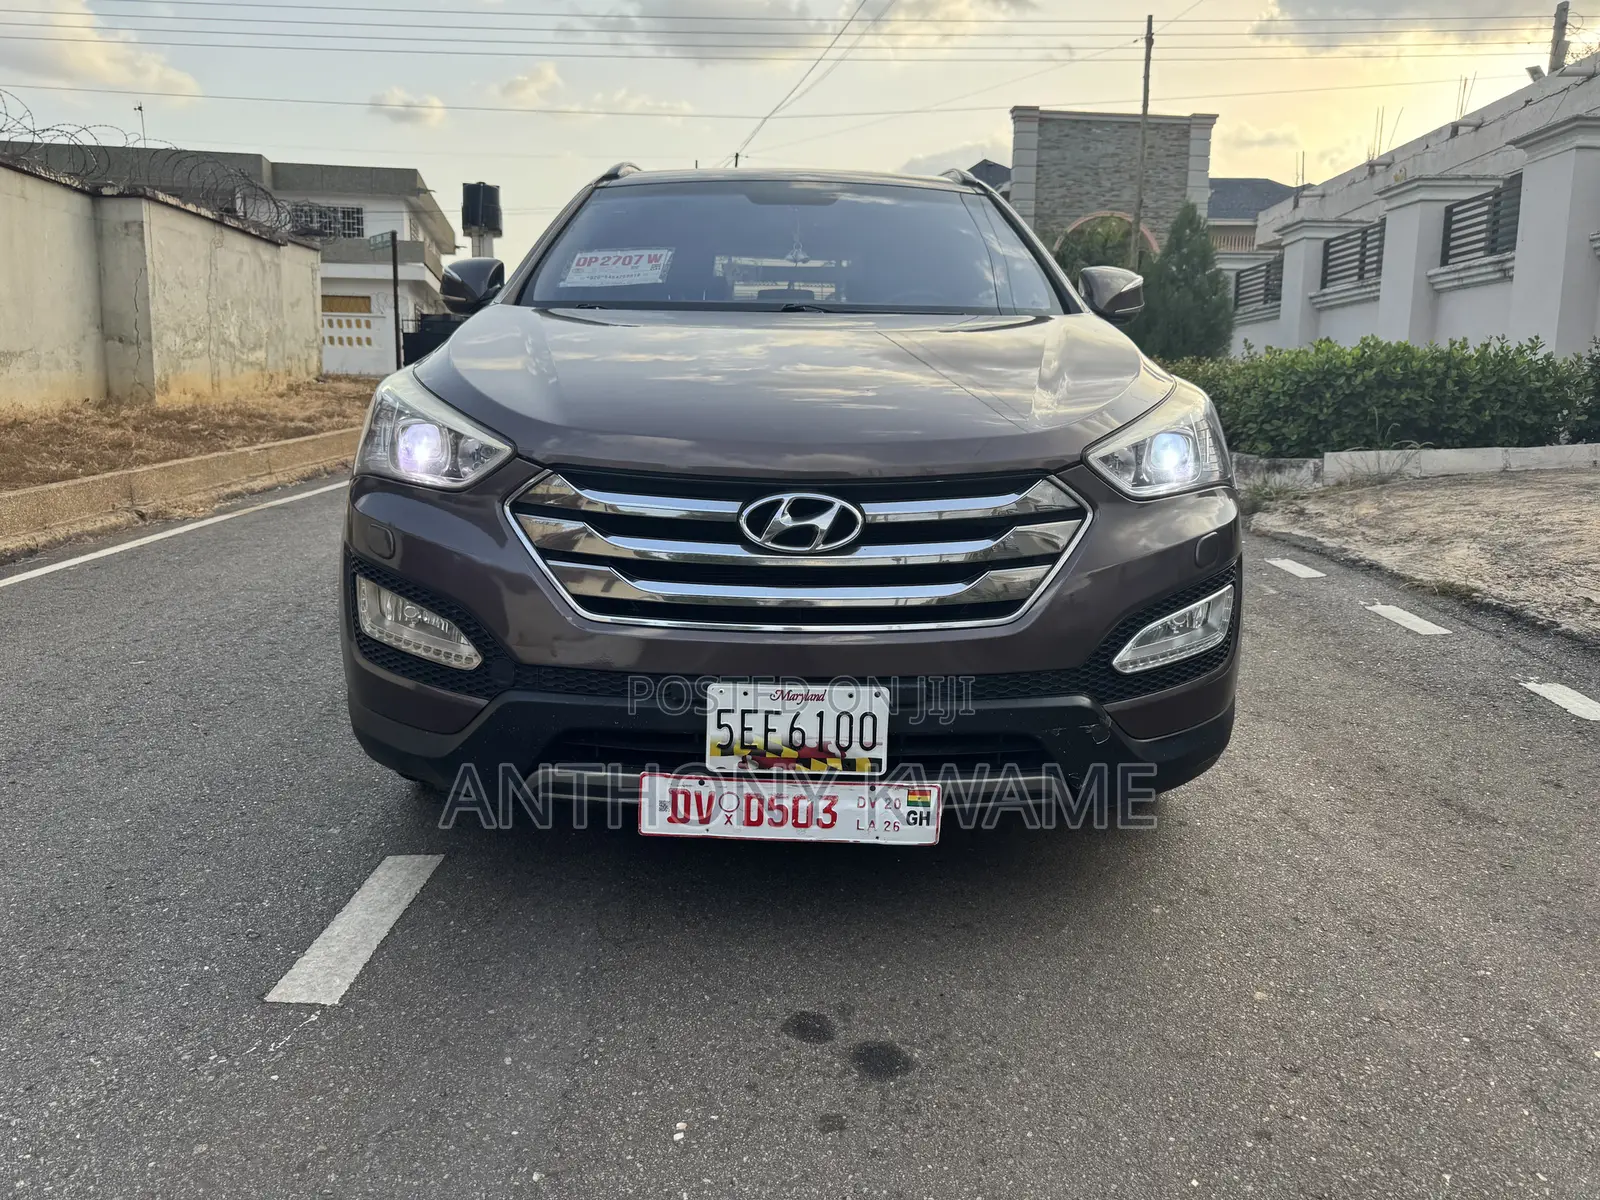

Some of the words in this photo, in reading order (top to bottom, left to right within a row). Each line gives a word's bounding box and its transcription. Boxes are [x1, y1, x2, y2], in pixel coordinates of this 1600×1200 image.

[769, 688, 827, 706] Maryland
[716, 708, 878, 751] 5EF6100
[667, 788, 715, 825] DV
[743, 792, 839, 829] D503
[884, 797, 902, 810] 20
[884, 820, 901, 832] 26
[906, 809, 931, 827] GH
